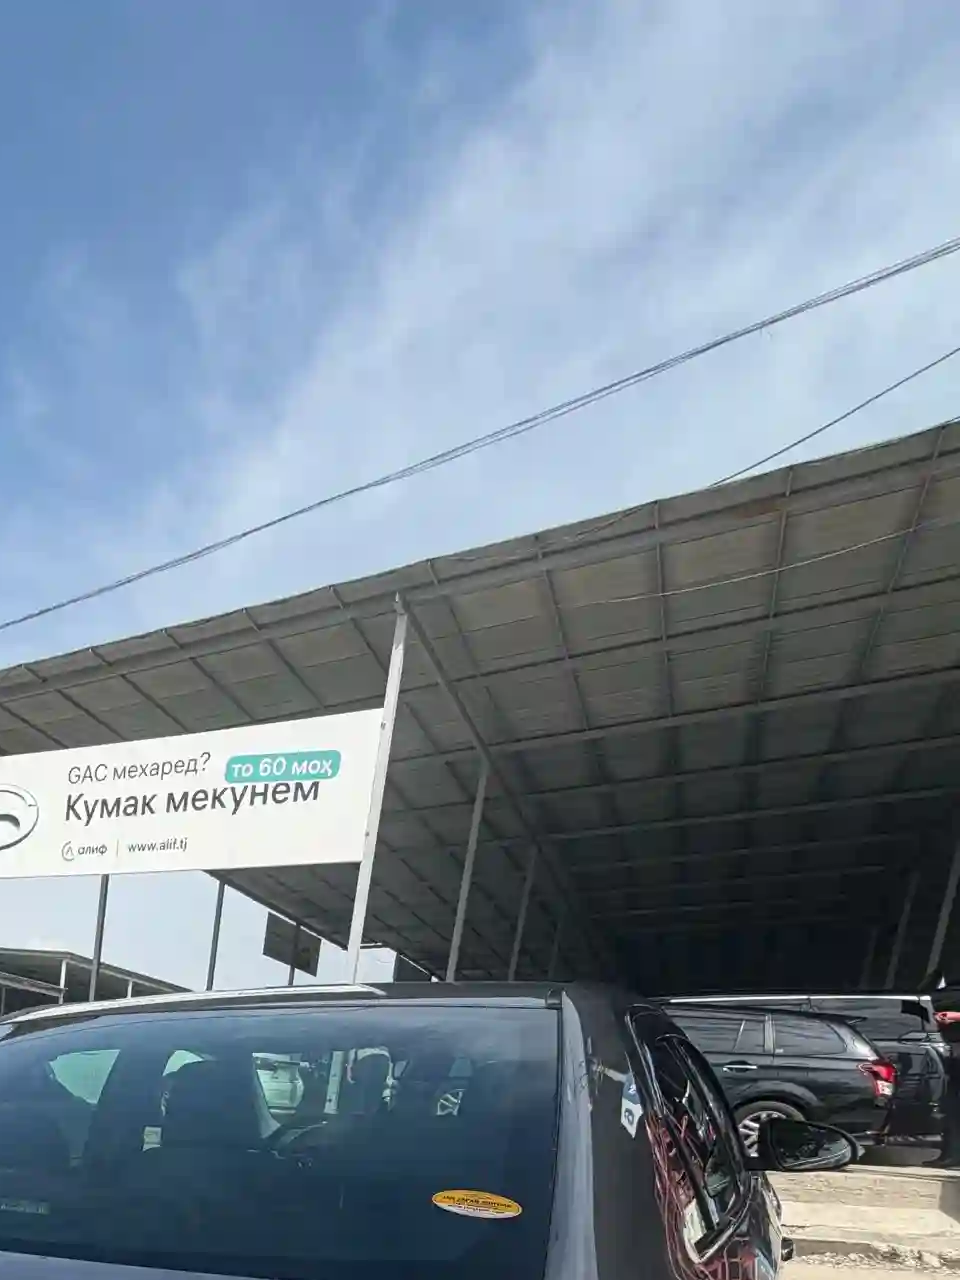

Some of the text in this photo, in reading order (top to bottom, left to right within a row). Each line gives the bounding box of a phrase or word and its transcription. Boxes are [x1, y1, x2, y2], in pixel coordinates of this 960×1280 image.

[68, 751, 211, 784] GAC мехаред?
[231, 763, 254, 778] то
[259, 756, 287, 777] 60
[65, 780, 320, 827] Кумак мекунем
[128, 837, 188, 852] www.alif.tj
